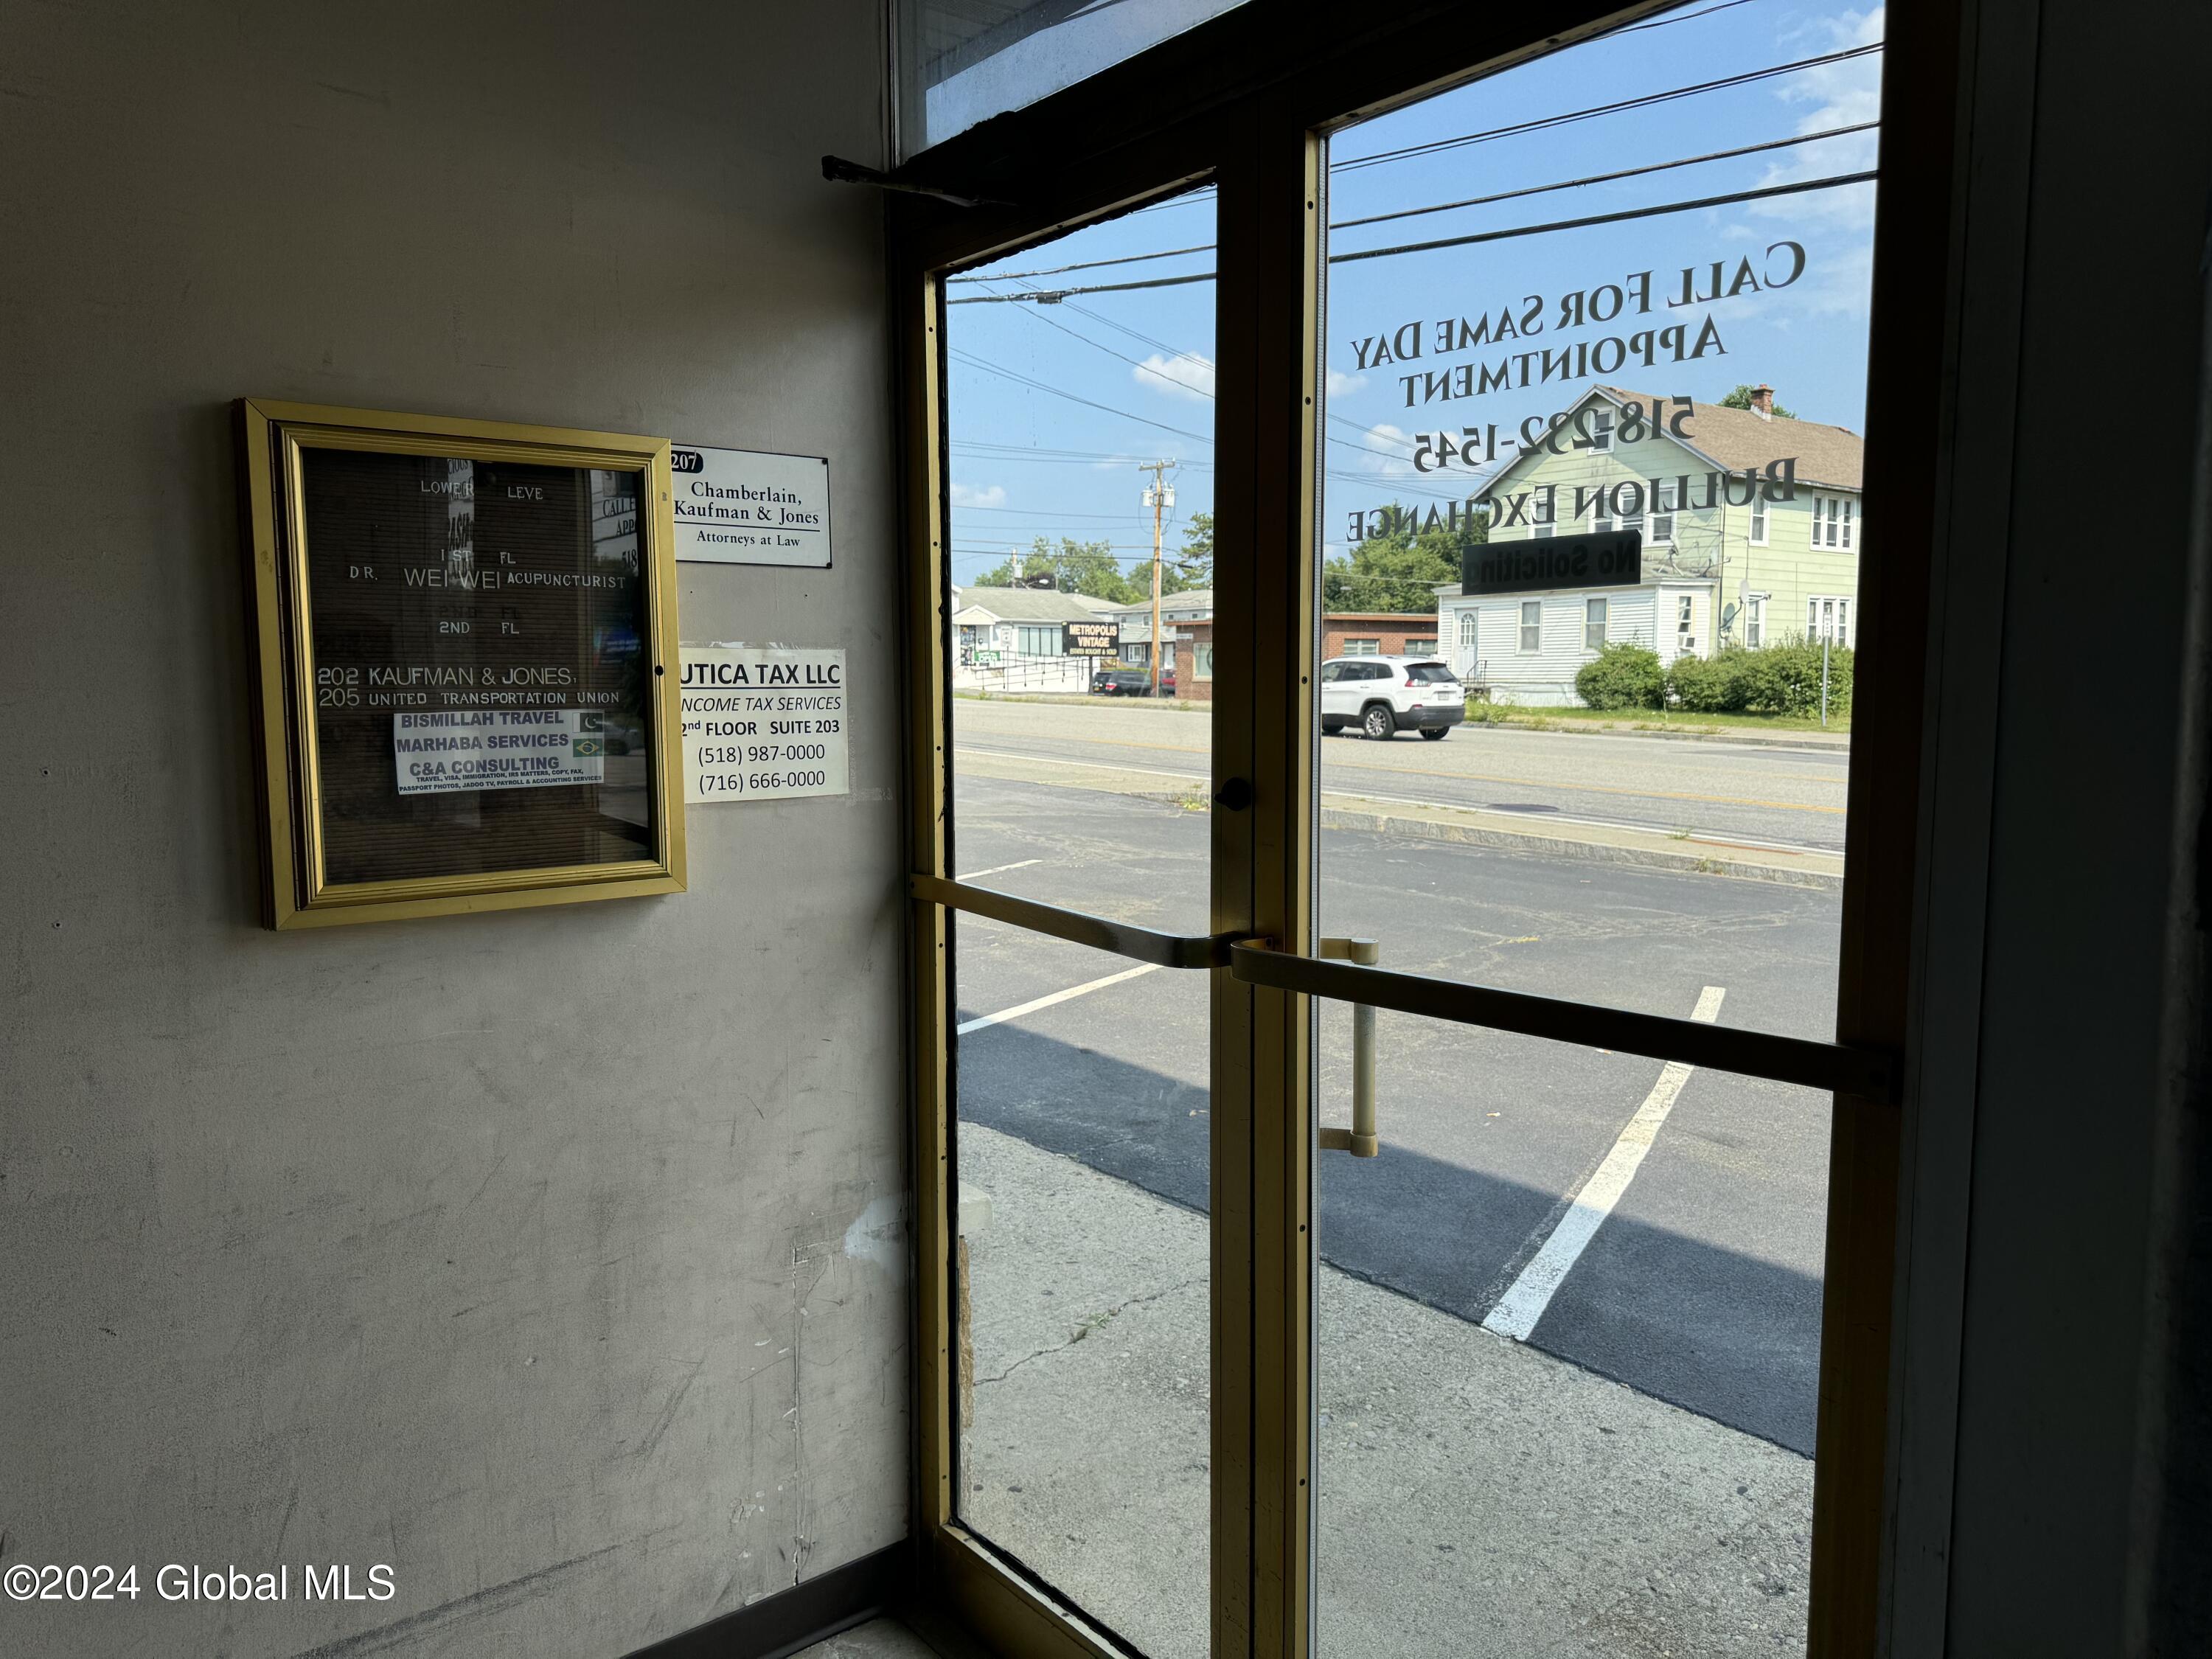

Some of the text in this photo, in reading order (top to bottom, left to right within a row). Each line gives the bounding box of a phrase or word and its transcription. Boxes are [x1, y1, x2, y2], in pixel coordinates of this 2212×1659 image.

[671, 453, 697, 470] 207
[507, 486, 543, 501] LEVE
[691, 481, 802, 506] Chamberlain,
[674, 499, 819, 526] Kaufman & Jones
[697, 529, 801, 547] Attorneys at Law
[500, 552, 516, 565] FL
[404, 568, 448, 588] WEI
[459, 571, 501, 589] WEI
[507, 572, 626, 589] ACUPUNCTURIST
[439, 622, 520, 634] 2ND FL
[1069, 625, 1117, 636] METROPOLIS
[1077, 636, 1110, 647] VINTAGE
[317, 667, 359, 686] 202
[369, 667, 473, 686] KAUFMAN
[481, 667, 497, 685] &
[680, 663, 841, 684] UTICA TAX LLC
[319, 689, 620, 707] 205 UNITED TRANSPORTATION UNION
[681, 697, 841, 712] NCOME TAX SERVICES
[401, 712, 564, 728] BISMILLAH TRAVEL
[706, 722, 757, 736] FLOOR
[770, 720, 813, 734] SUITE
[815, 720, 840, 733] 203
[397, 734, 569, 753] MARHABA SERVICES
[698, 744, 826, 768] (518) 987-0000
[409, 757, 560, 777] C&A CONSULTING
[434, 782, 462, 790] PHOTOS,
[496, 778, 524, 786] PAYROLL
[699, 771, 826, 795] (716) 666-0000
